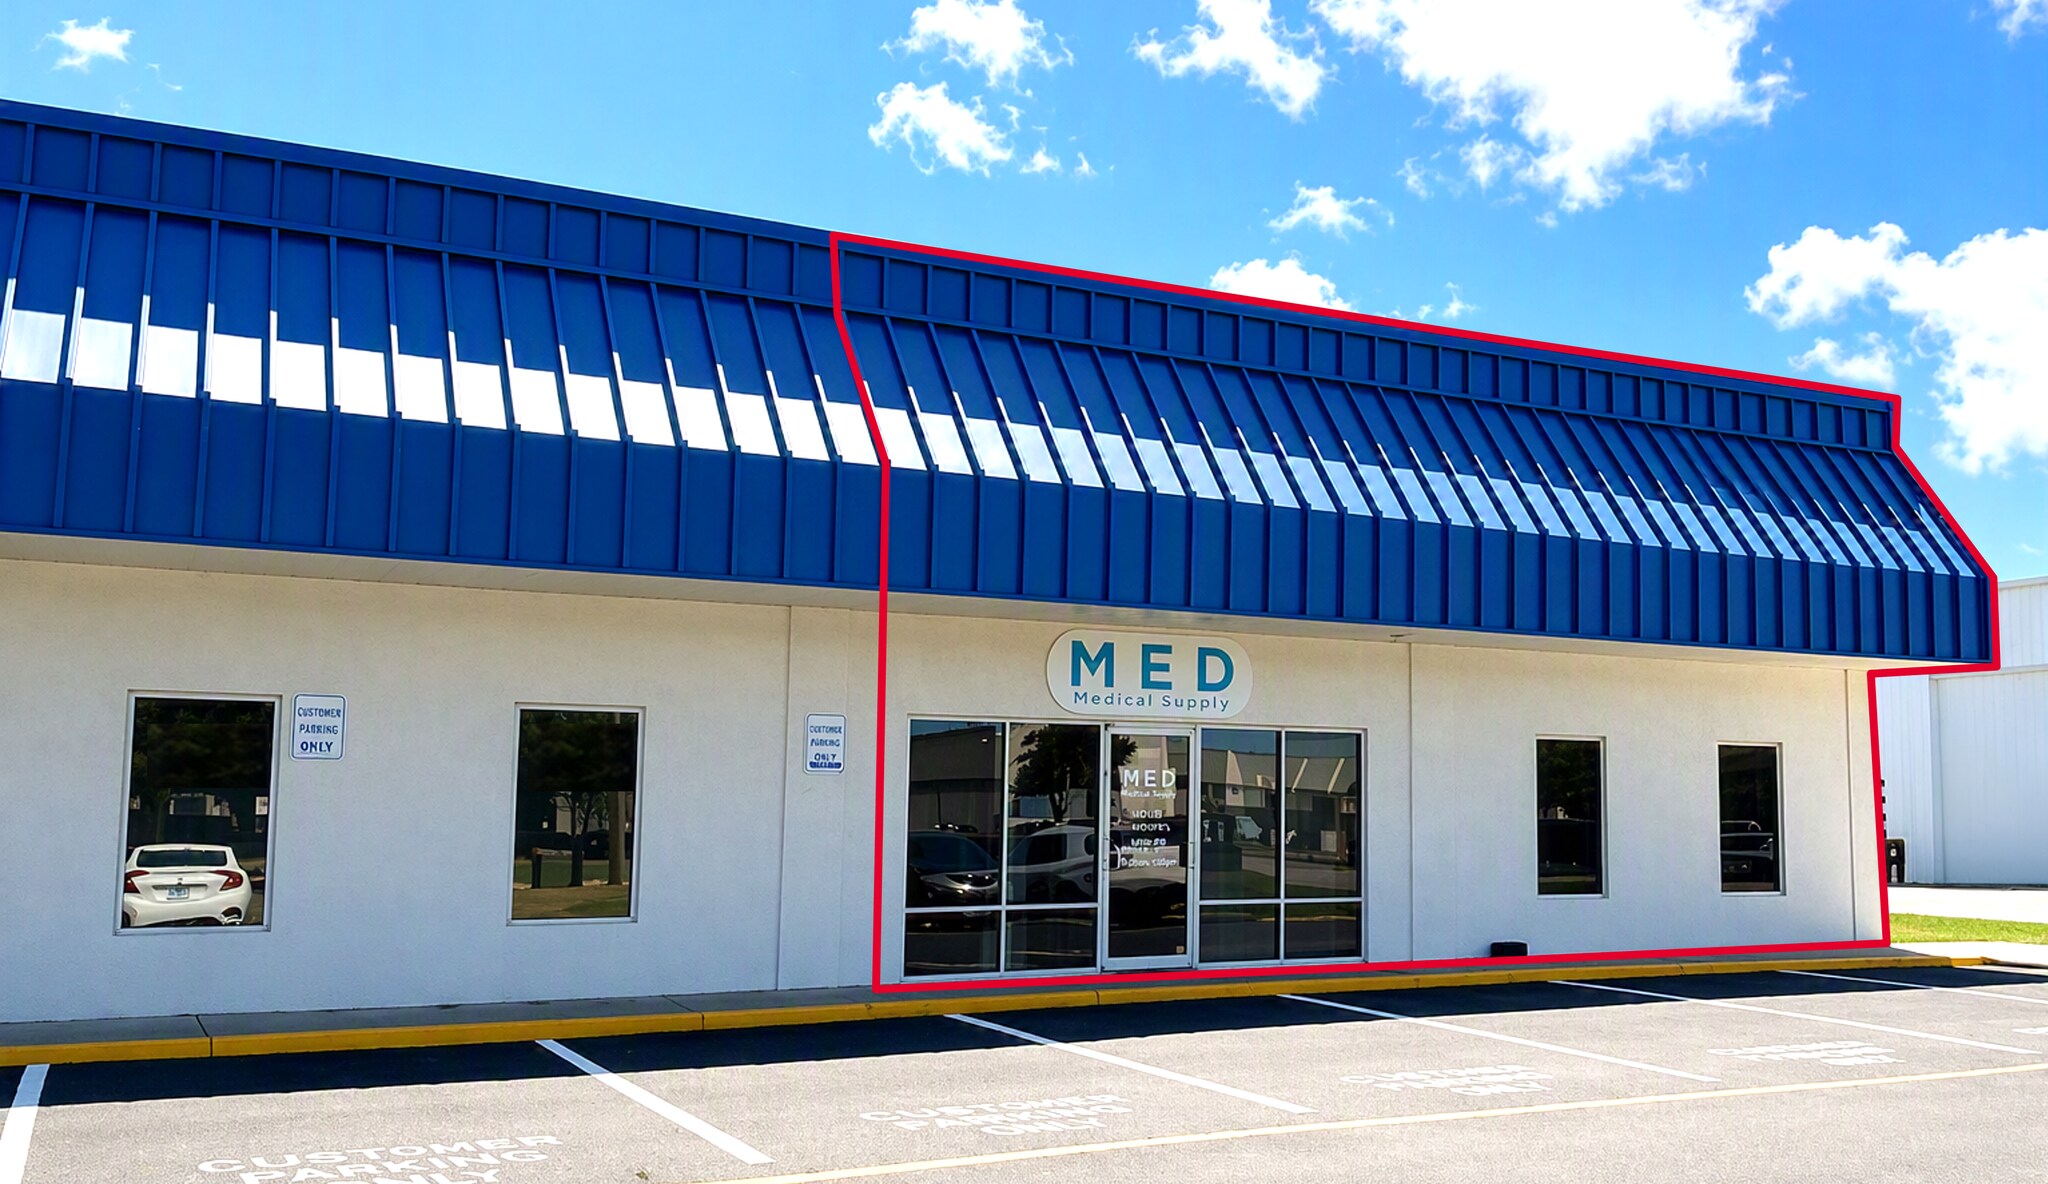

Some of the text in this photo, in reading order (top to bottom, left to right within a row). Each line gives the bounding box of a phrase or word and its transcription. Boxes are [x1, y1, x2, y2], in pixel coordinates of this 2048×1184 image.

[1071, 640, 1234, 692] MED
[1074, 691, 1230, 712] Medical Supply
[300, 741, 333, 753] ONLY
[1123, 769, 1176, 788] MED
[198, 1135, 563, 1173] CUSTOMER
[239, 1150, 550, 1184] PARKING
[325, 1168, 501, 1184] NLY
